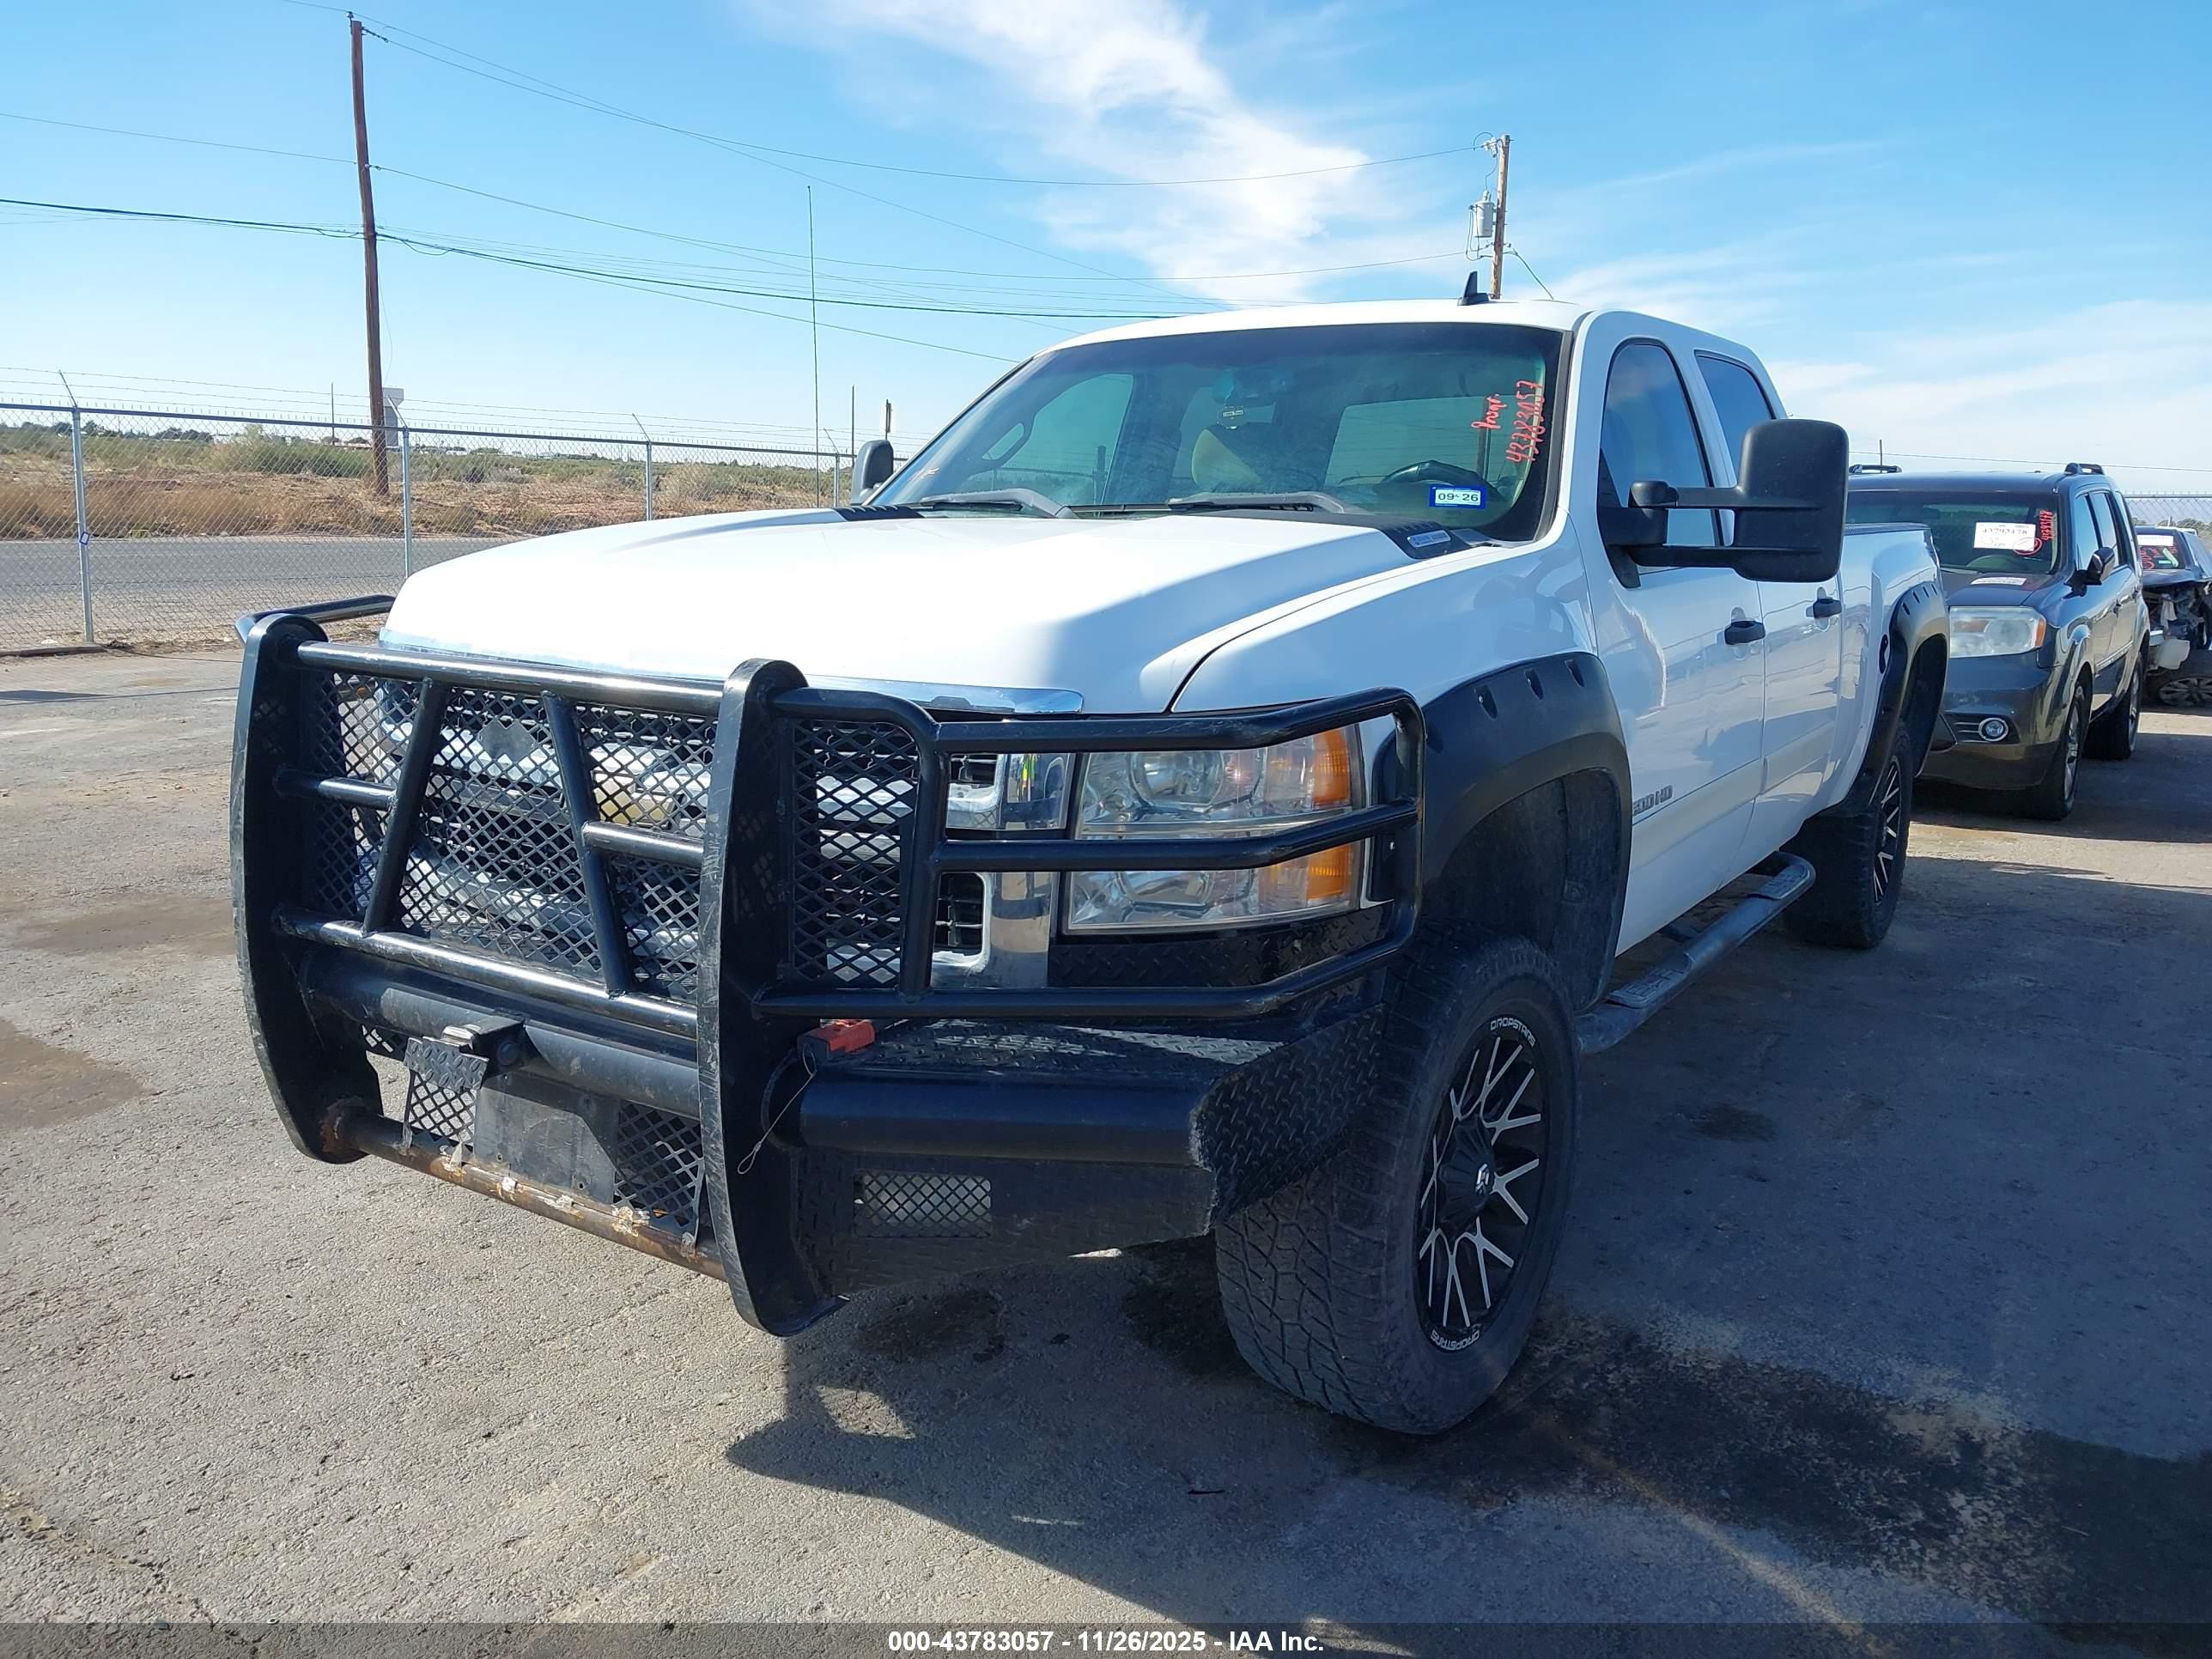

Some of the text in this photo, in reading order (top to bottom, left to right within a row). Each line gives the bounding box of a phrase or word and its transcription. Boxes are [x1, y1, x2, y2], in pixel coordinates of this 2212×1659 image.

[1437, 492, 1479, 502] 09 26
[1490, 1017, 1536, 1048] DROPSTARS
[1430, 1328, 1480, 1351] DROPSTARS
